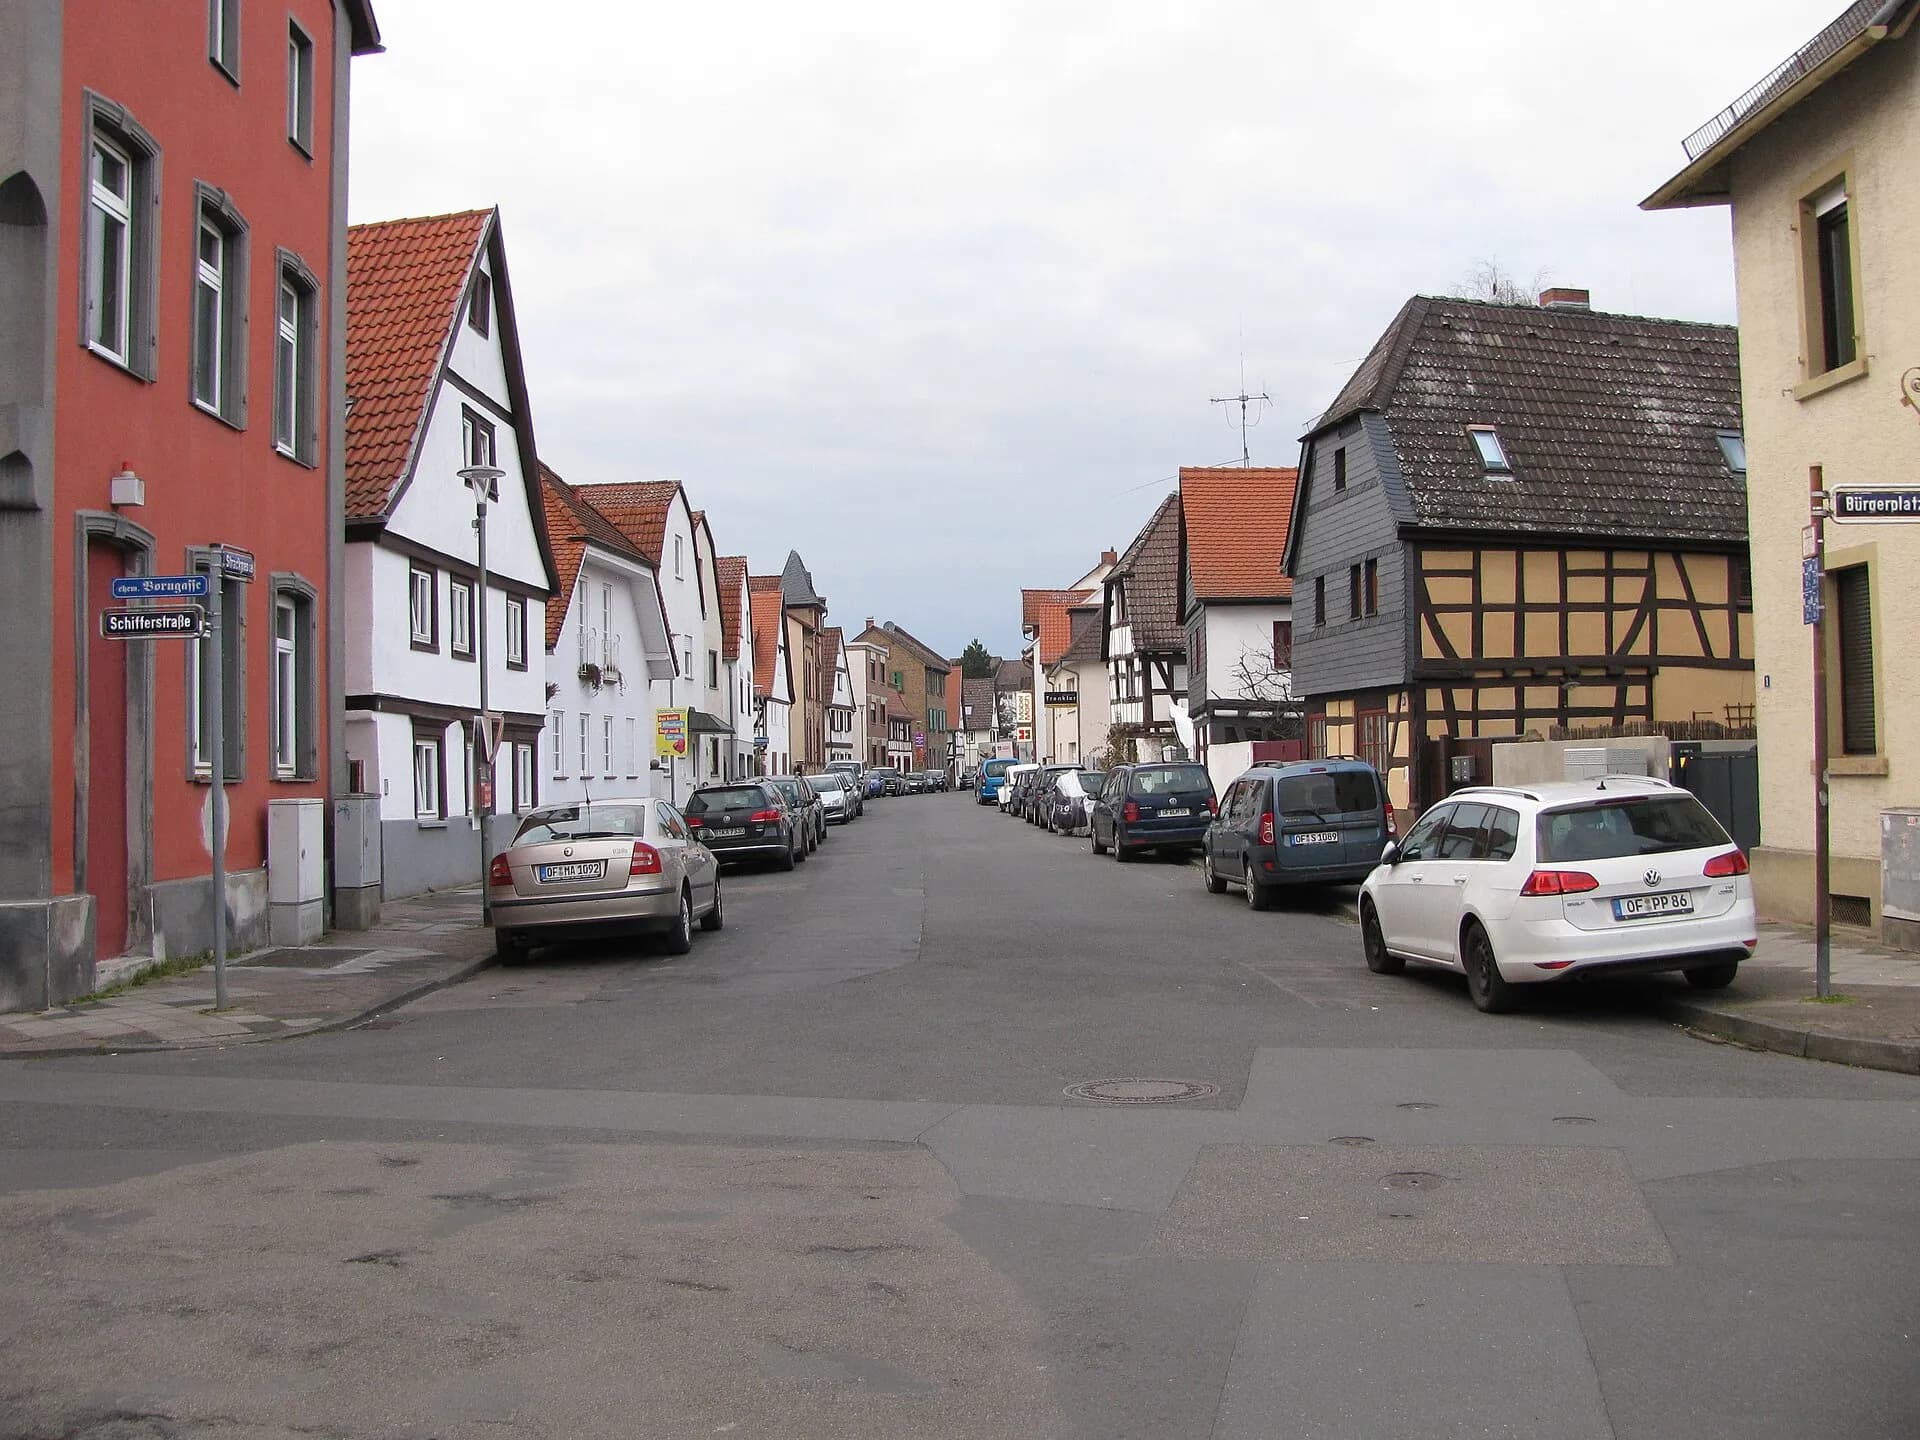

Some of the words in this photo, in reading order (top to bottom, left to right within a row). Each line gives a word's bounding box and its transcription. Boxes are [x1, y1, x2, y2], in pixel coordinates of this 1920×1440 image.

[110, 614, 191, 630] Schifferstraße
[1295, 835, 1306, 843] OF
[1317, 832, 1337, 841] 1089
[546, 867, 557, 878] OF
[564, 866, 576, 876] MA
[577, 864, 599, 875] 1092
[1626, 899, 1643, 913] OF
[1652, 896, 1669, 911] PP
[1671, 894, 1688, 908] 86
